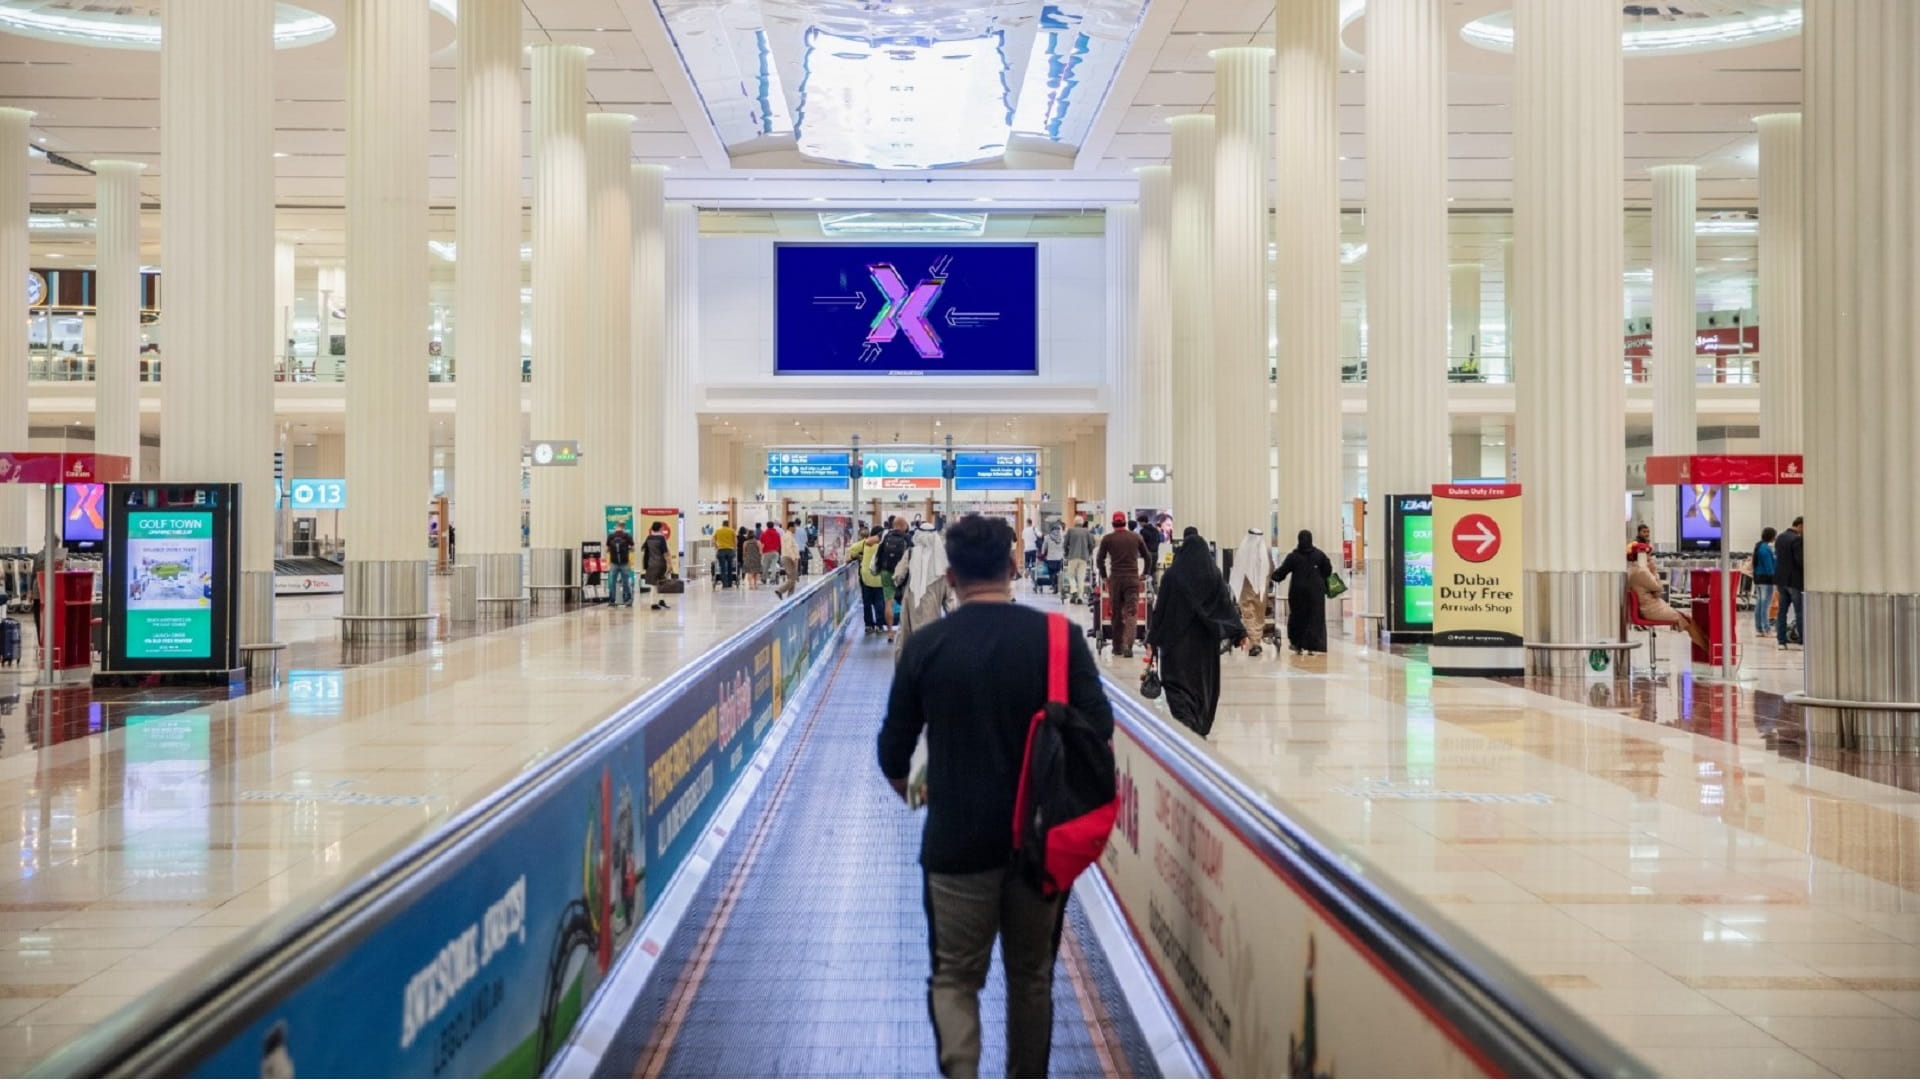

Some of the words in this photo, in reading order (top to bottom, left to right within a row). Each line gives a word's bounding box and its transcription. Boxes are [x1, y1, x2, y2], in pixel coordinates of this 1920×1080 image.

[318, 485, 341, 503] 13
[1471, 488, 1488, 496] Duty
[139, 519, 168, 529] GOLF
[170, 519, 202, 529] TOWN
[1454, 573, 1500, 586] Dubai
[1440, 587, 1477, 601] Duty
[1482, 587, 1513, 599] Free
[1440, 603, 1482, 612] Arrivals
[1485, 603, 1512, 615] Shop
